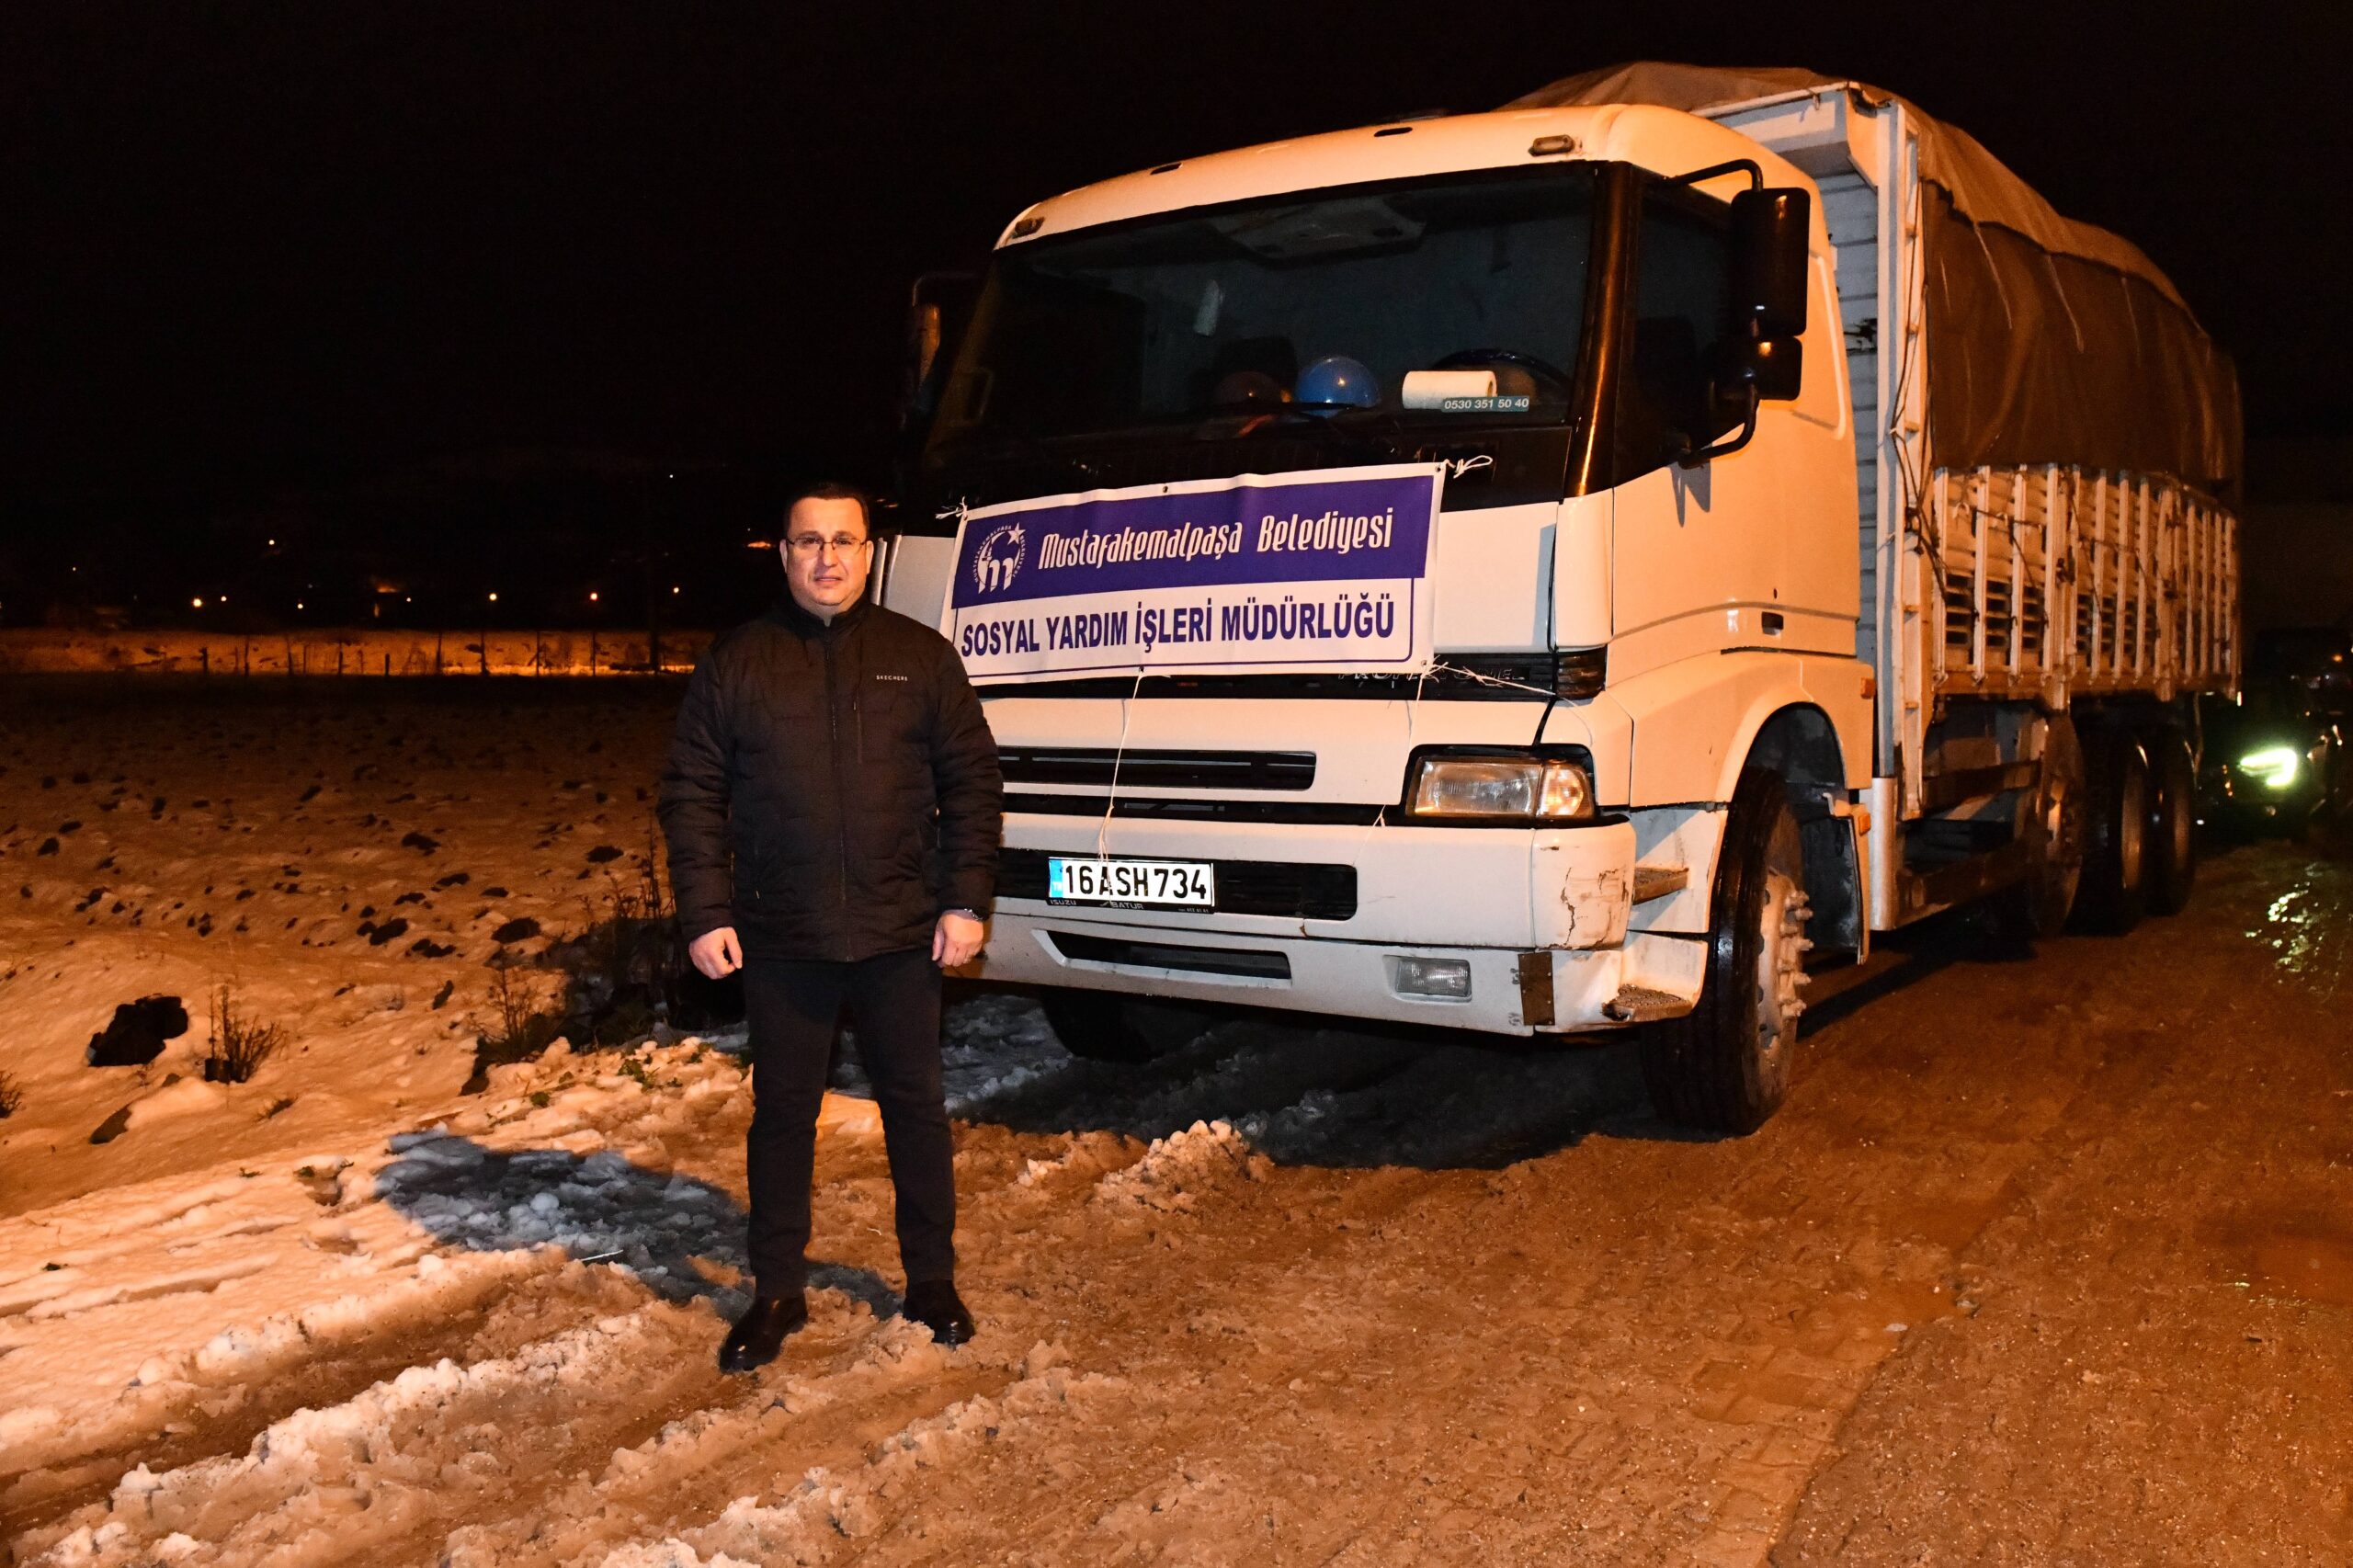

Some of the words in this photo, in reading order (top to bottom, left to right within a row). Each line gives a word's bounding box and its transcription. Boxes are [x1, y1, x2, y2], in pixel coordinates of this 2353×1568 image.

[1444, 399, 1471, 410] 0530
[1474, 399, 1494, 409] 351
[1497, 398, 1512, 408] 50
[1515, 397, 1529, 408] 40
[1038, 521, 1243, 570] Mustafakemalpaşa
[1256, 507, 1393, 554] Belediyesi
[961, 619, 1040, 658] SOSYAL
[1046, 611, 1129, 651] YARDIM
[1134, 597, 1212, 653] İŞLERİ
[1221, 592, 1394, 642] MÜDÜRLÜĞÜ
[1111, 902, 1144, 910] BATUR
